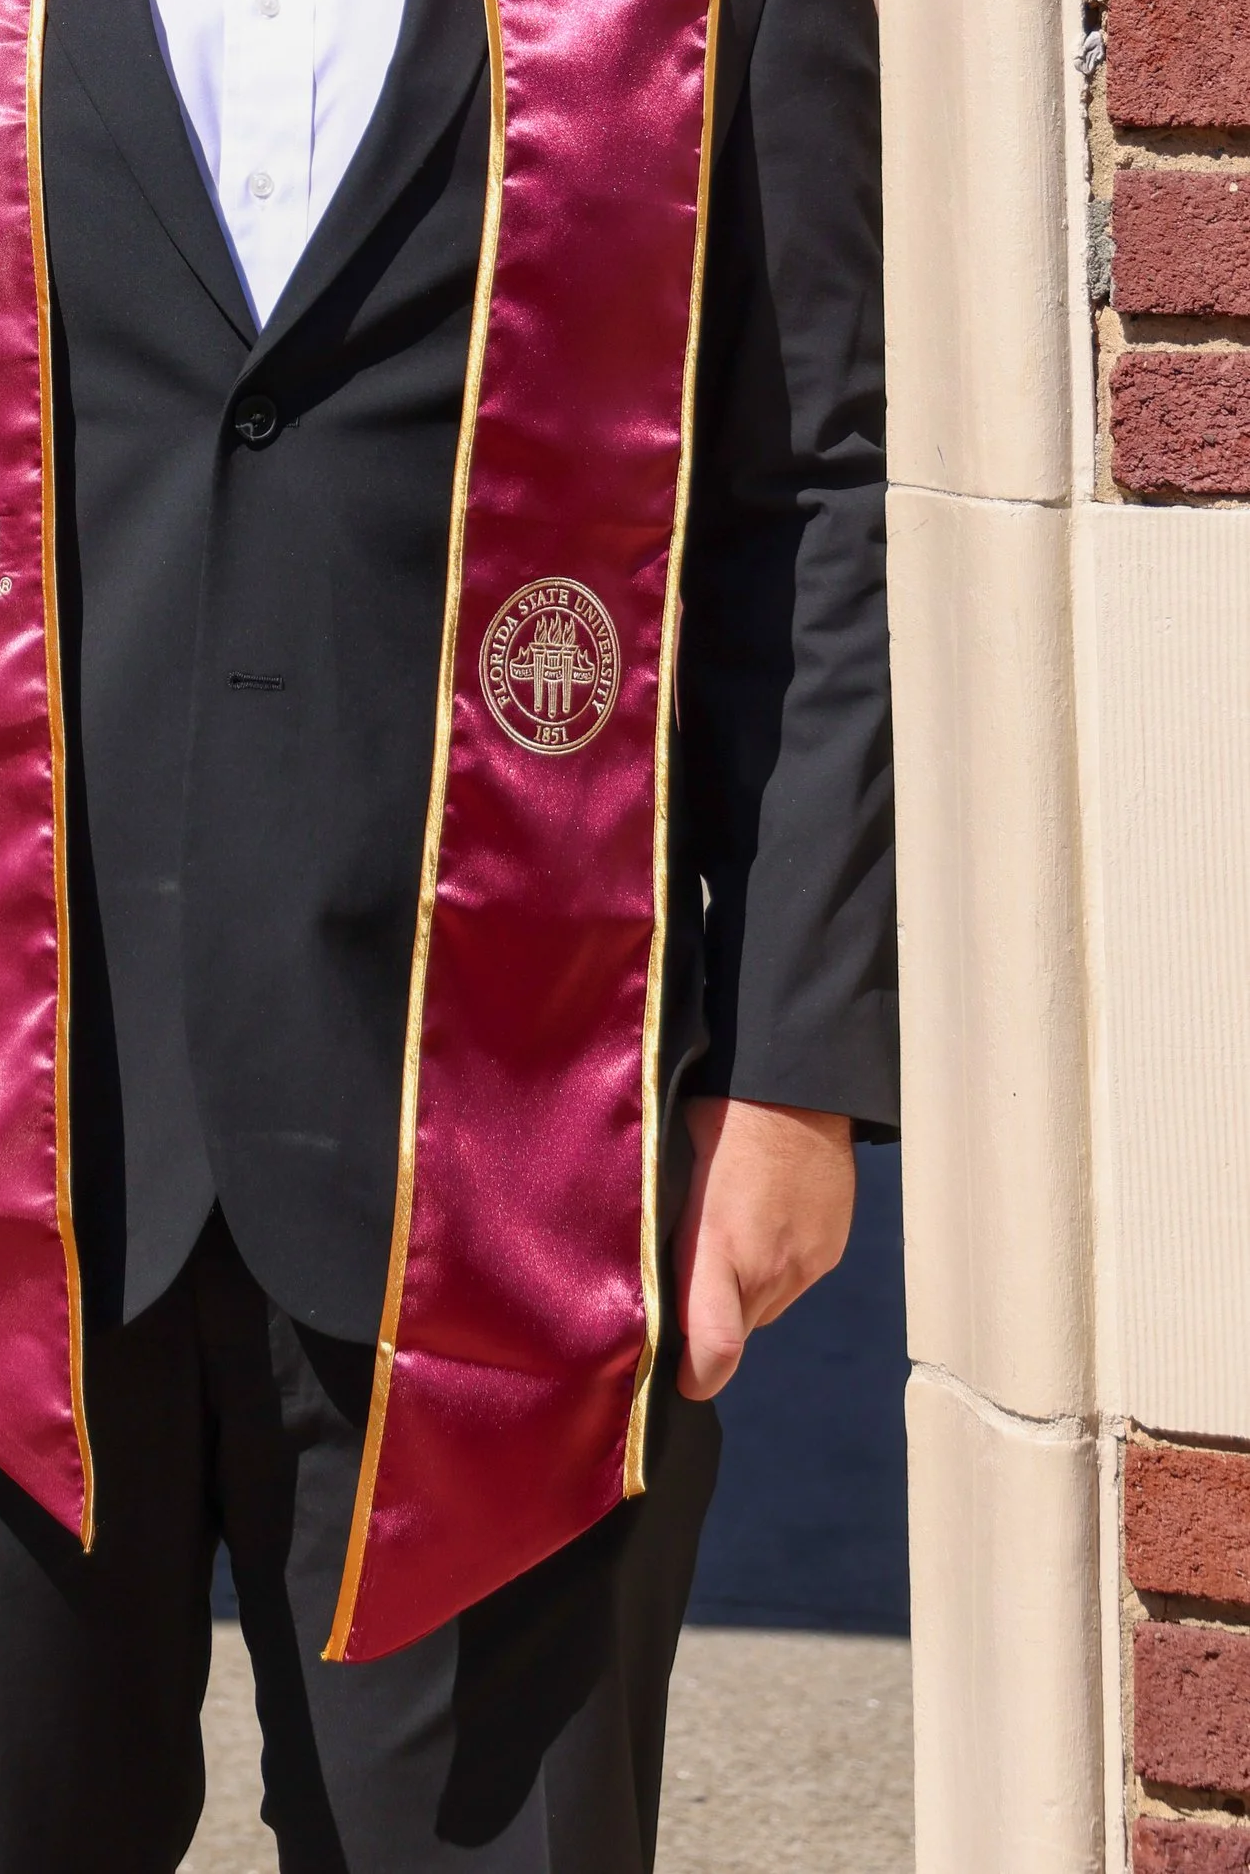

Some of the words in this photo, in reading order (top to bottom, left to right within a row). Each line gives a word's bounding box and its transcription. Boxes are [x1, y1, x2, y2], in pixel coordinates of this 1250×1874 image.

[490, 615, 519, 710] FLORIDA
[518, 588, 570, 616] STATE
[574, 596, 613, 715] UNIVERSITY
[534, 726, 569, 744] 1851
